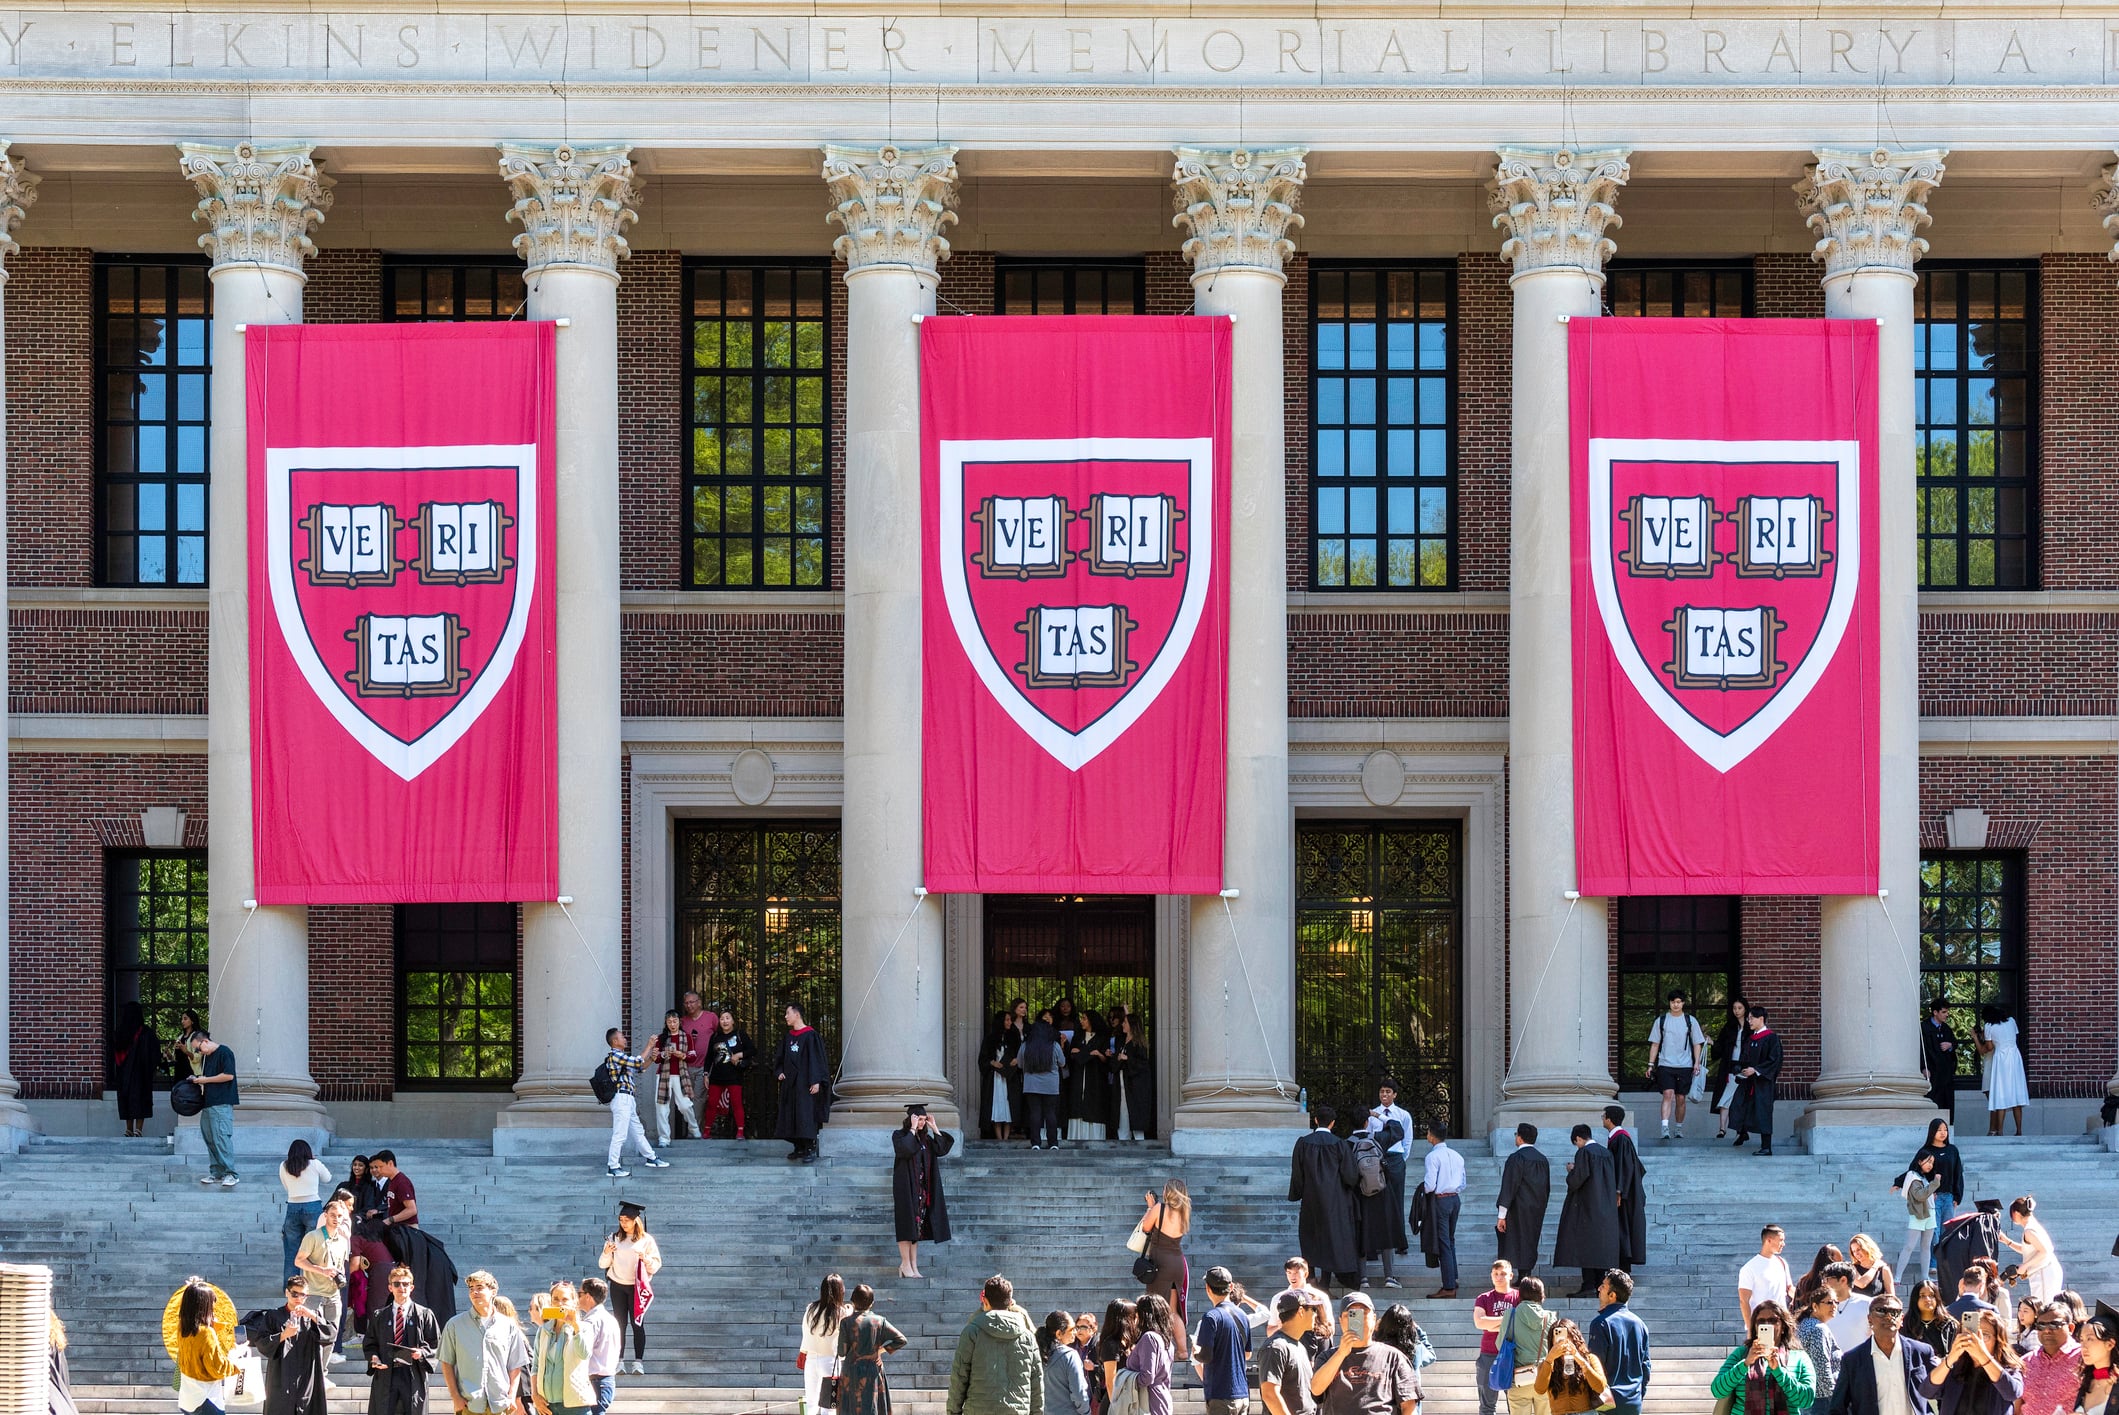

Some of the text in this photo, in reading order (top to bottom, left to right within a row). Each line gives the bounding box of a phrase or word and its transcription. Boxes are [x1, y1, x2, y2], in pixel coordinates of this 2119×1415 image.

[108, 22, 422, 69] ELKINS
[498, 25, 919, 72] WIDENER
[988, 27, 1470, 74] MEMORIAL
[1545, 28, 1922, 74] LIBRARY
[1993, 29, 2038, 74] A
[324, 523, 478, 556] VE RI
[997, 515, 1149, 548] VE RI
[1644, 517, 1797, 548] VE RI
[377, 633, 440, 666] TAS
[1047, 624, 1108, 656] TAS
[1694, 625, 1756, 658] TAS
